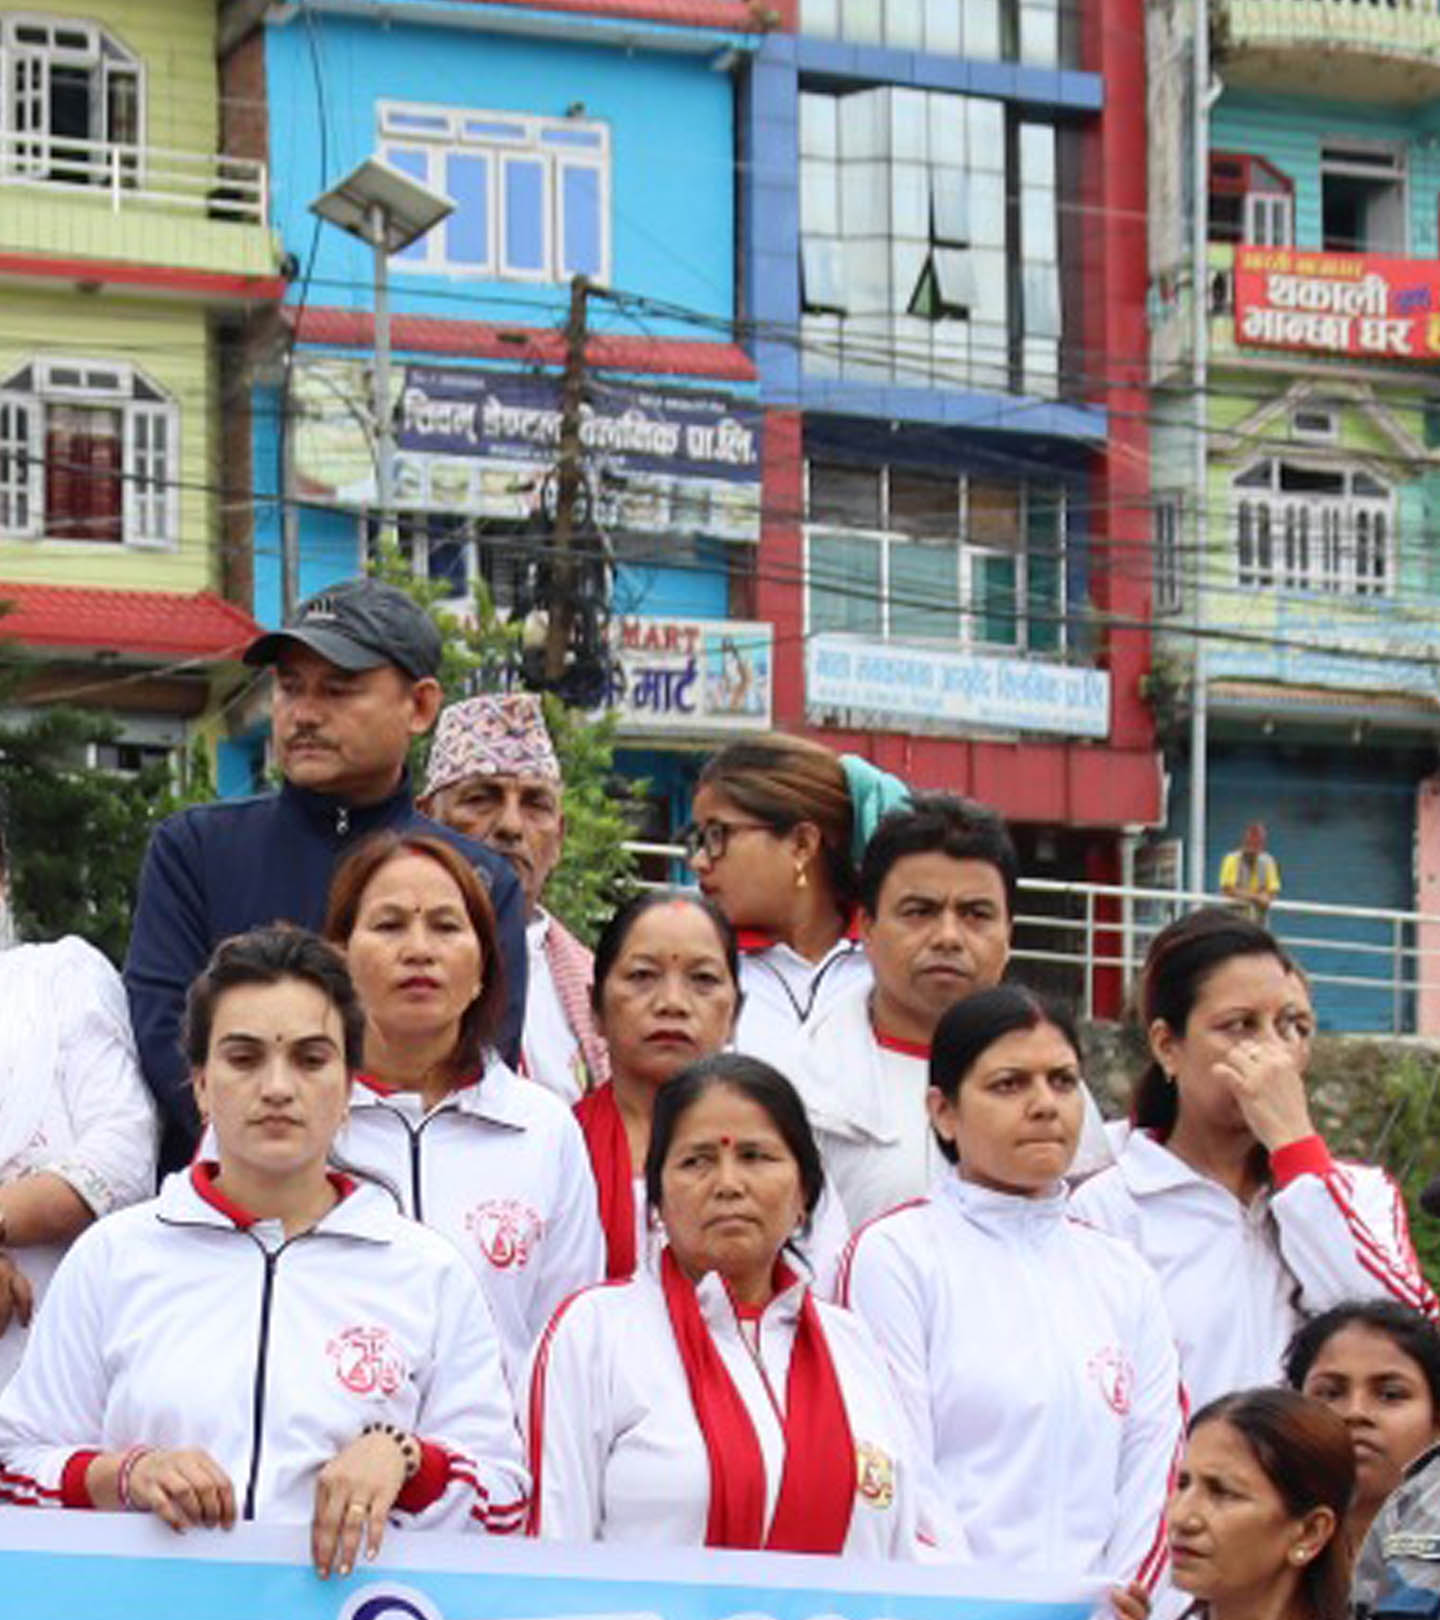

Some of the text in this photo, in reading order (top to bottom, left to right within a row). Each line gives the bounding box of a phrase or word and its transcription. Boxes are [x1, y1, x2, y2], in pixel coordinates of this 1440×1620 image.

[1267, 272, 1389, 317] थकाली
[1358, 317, 1414, 355] घर
[623, 622, 700, 649] MART
[631, 652, 699, 713] मार्ट
